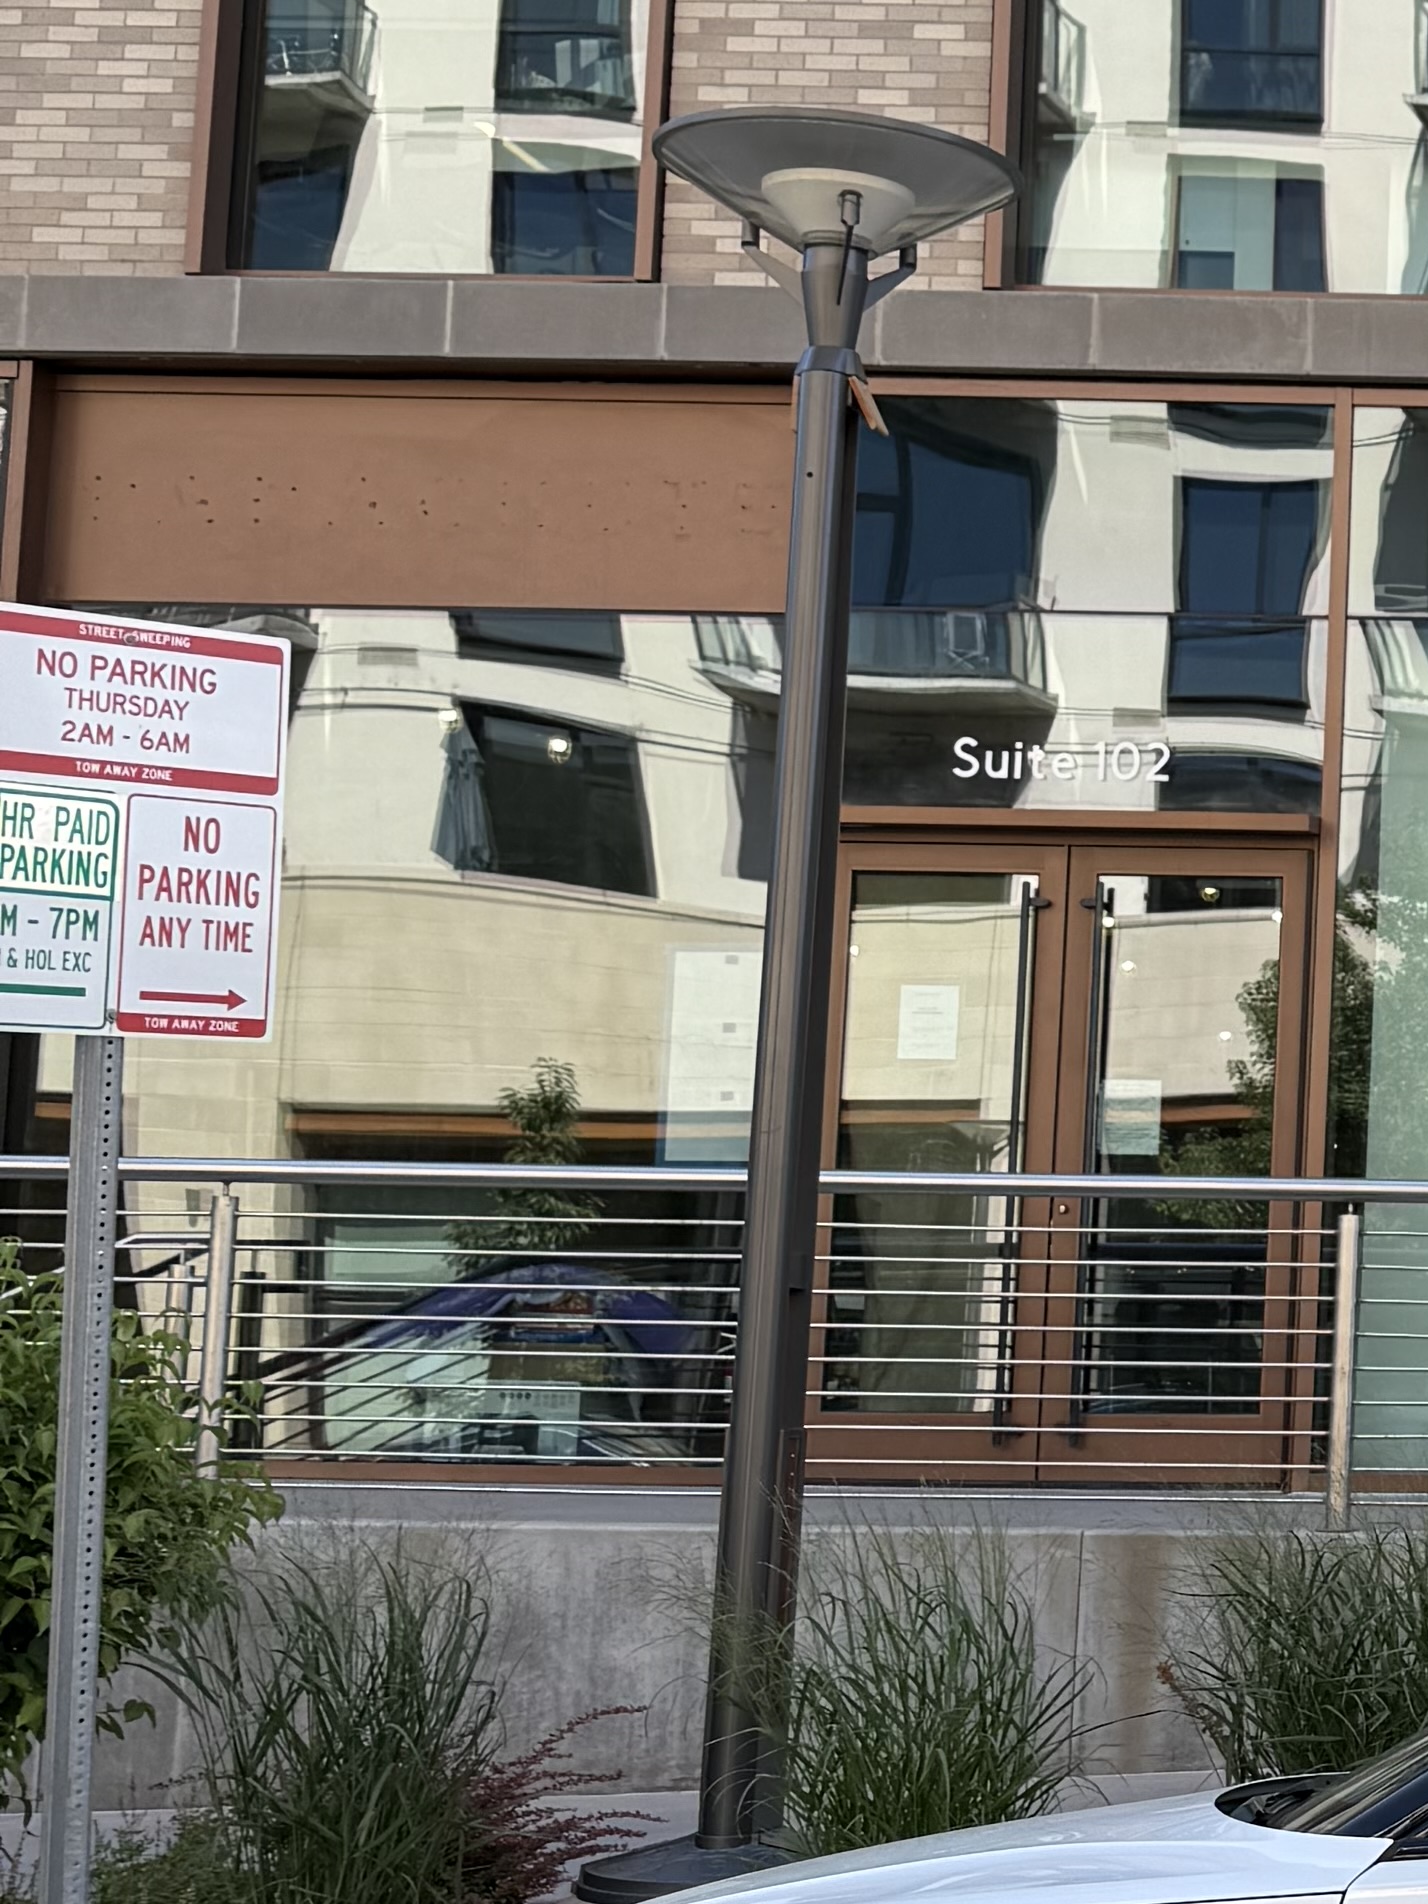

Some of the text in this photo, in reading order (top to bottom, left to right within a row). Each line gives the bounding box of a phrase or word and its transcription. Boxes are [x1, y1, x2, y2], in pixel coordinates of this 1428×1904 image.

[79, 623, 192, 649] STREET SWEEPING
[36, 647, 218, 695] NO PARKING
[64, 687, 190, 721] THURSDAY
[60, 719, 115, 747] 2AM
[139, 728, 191, 755] 6AM
[75, 760, 173, 781] TOW AWAY ZONE
[952, 736, 1172, 783] Suite 102
[1, 799, 111, 847] HR PAID
[183, 815, 222, 855] NO
[0, 842, 110, 889] PARKING
[137, 863, 261, 909] PARKING
[49, 906, 100, 942] 7PM
[138, 915, 255, 953] ANY TIME
[7, 947, 92, 973] & HOL EXC
[144, 1016, 240, 1033] TOW AWAY ZONE
